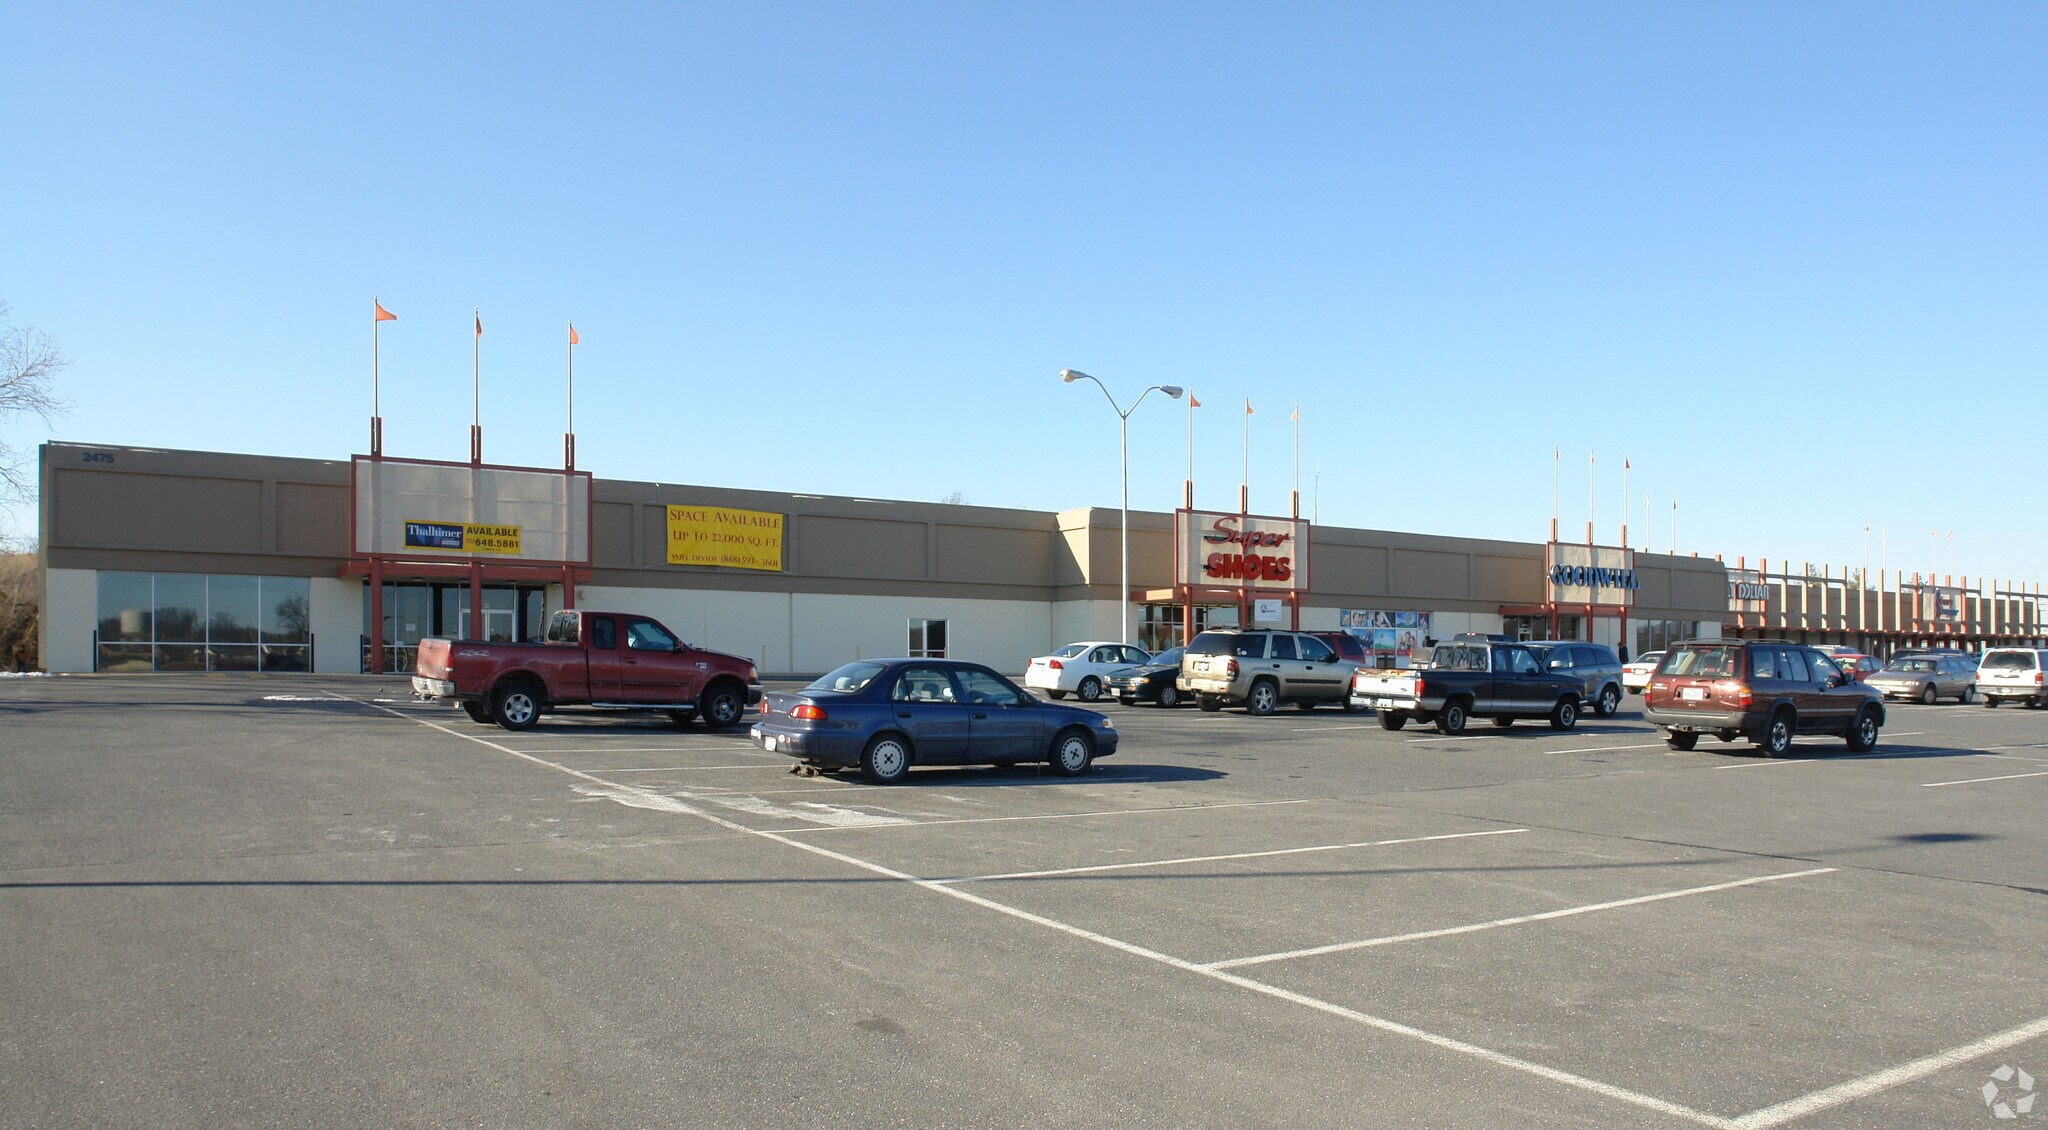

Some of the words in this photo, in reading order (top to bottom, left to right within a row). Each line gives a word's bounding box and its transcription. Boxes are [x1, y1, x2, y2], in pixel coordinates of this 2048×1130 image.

[82, 452, 114, 463] 2475
[670, 509, 708, 522] SPACE
[714, 511, 780, 529] AVAILABLE
[407, 524, 462, 538] Thalhimer
[466, 526, 518, 537] AVAILABLE
[673, 530, 689, 541] UP
[694, 531, 708, 541] TO
[1204, 515, 1290, 554] Super
[1207, 552, 1291, 581] SHOES
[1550, 563, 1640, 591] GOODWILL
